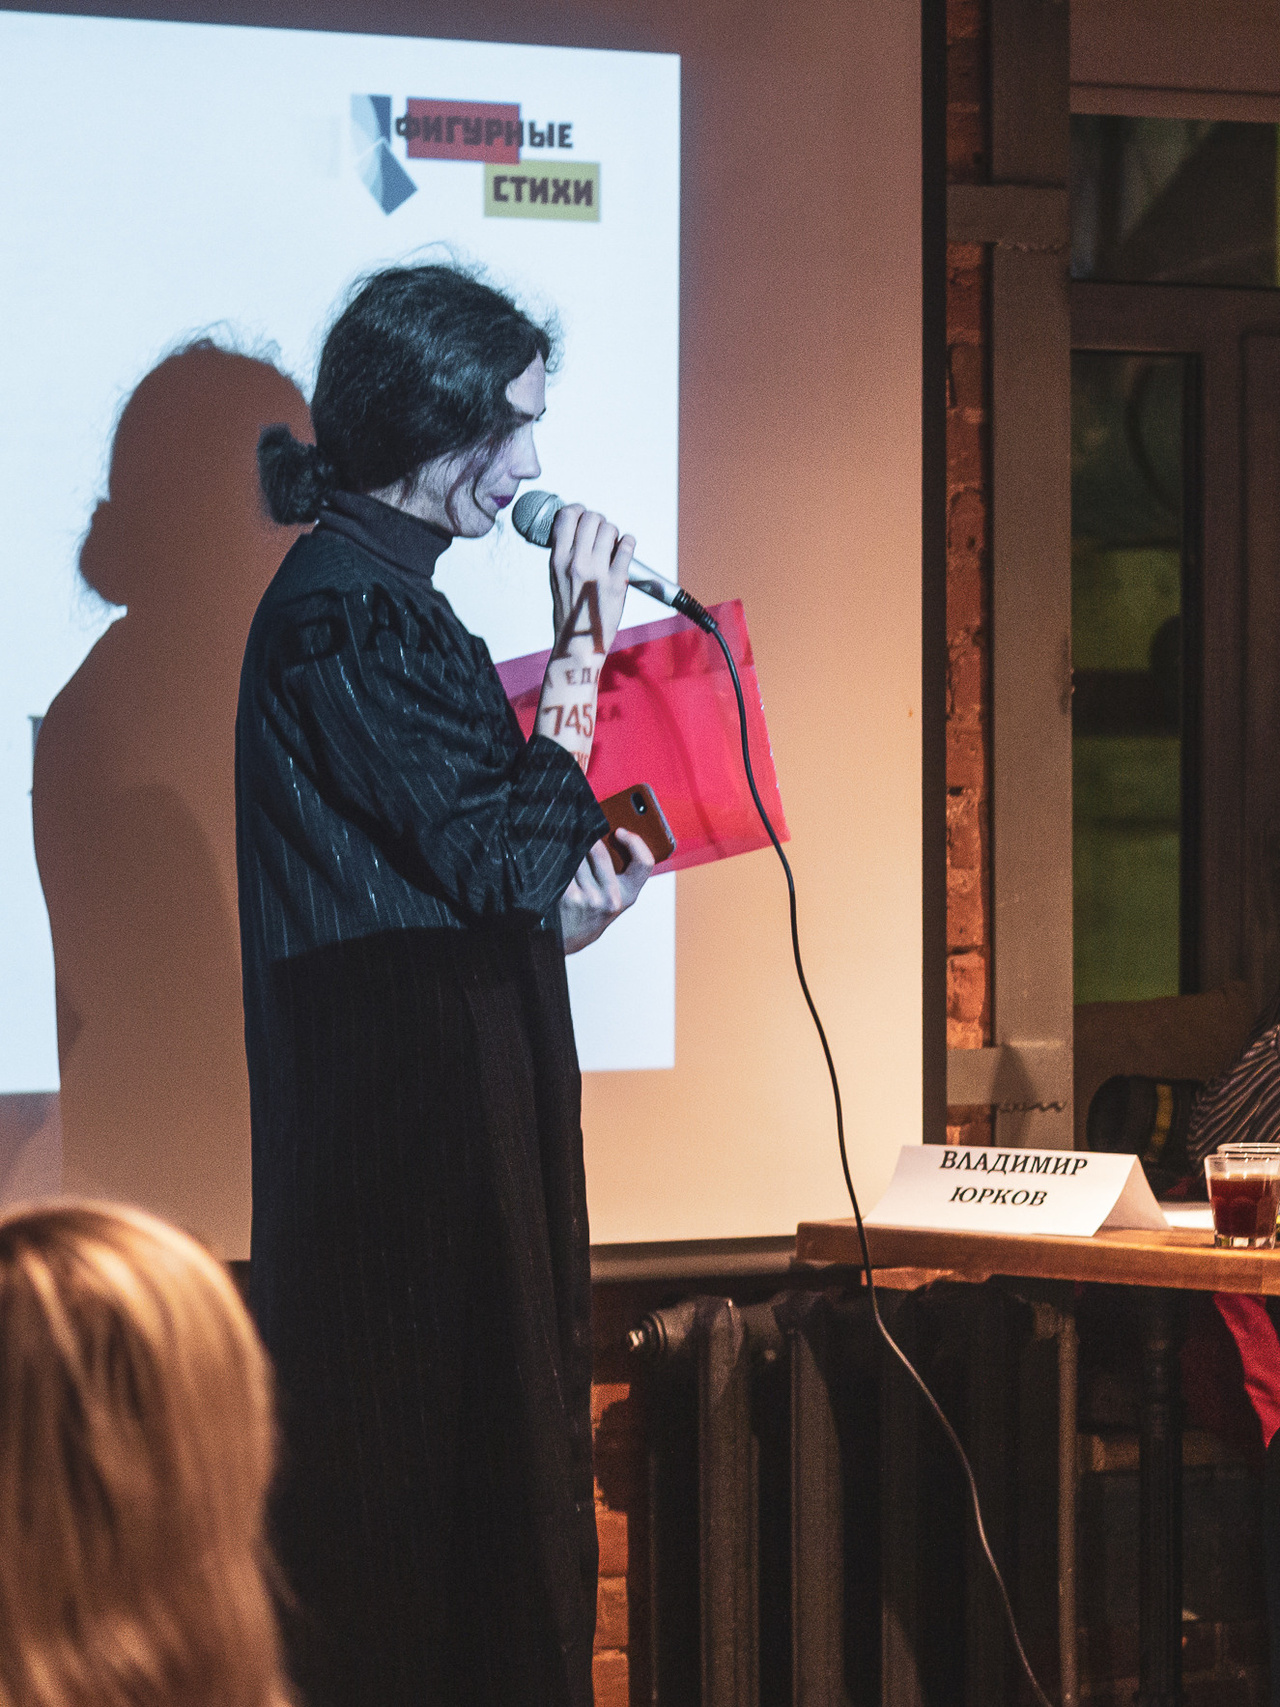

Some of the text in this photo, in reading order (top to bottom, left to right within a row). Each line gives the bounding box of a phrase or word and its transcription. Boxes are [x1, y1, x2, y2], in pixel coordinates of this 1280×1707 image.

[395, 113, 573, 149] ФИГУРНЫЕ
[493, 175, 593, 206] СТИХИ
[939, 1150, 1088, 1176] ВЛАДИМИР
[949, 1186, 1048, 1207] ЮРКОВ
